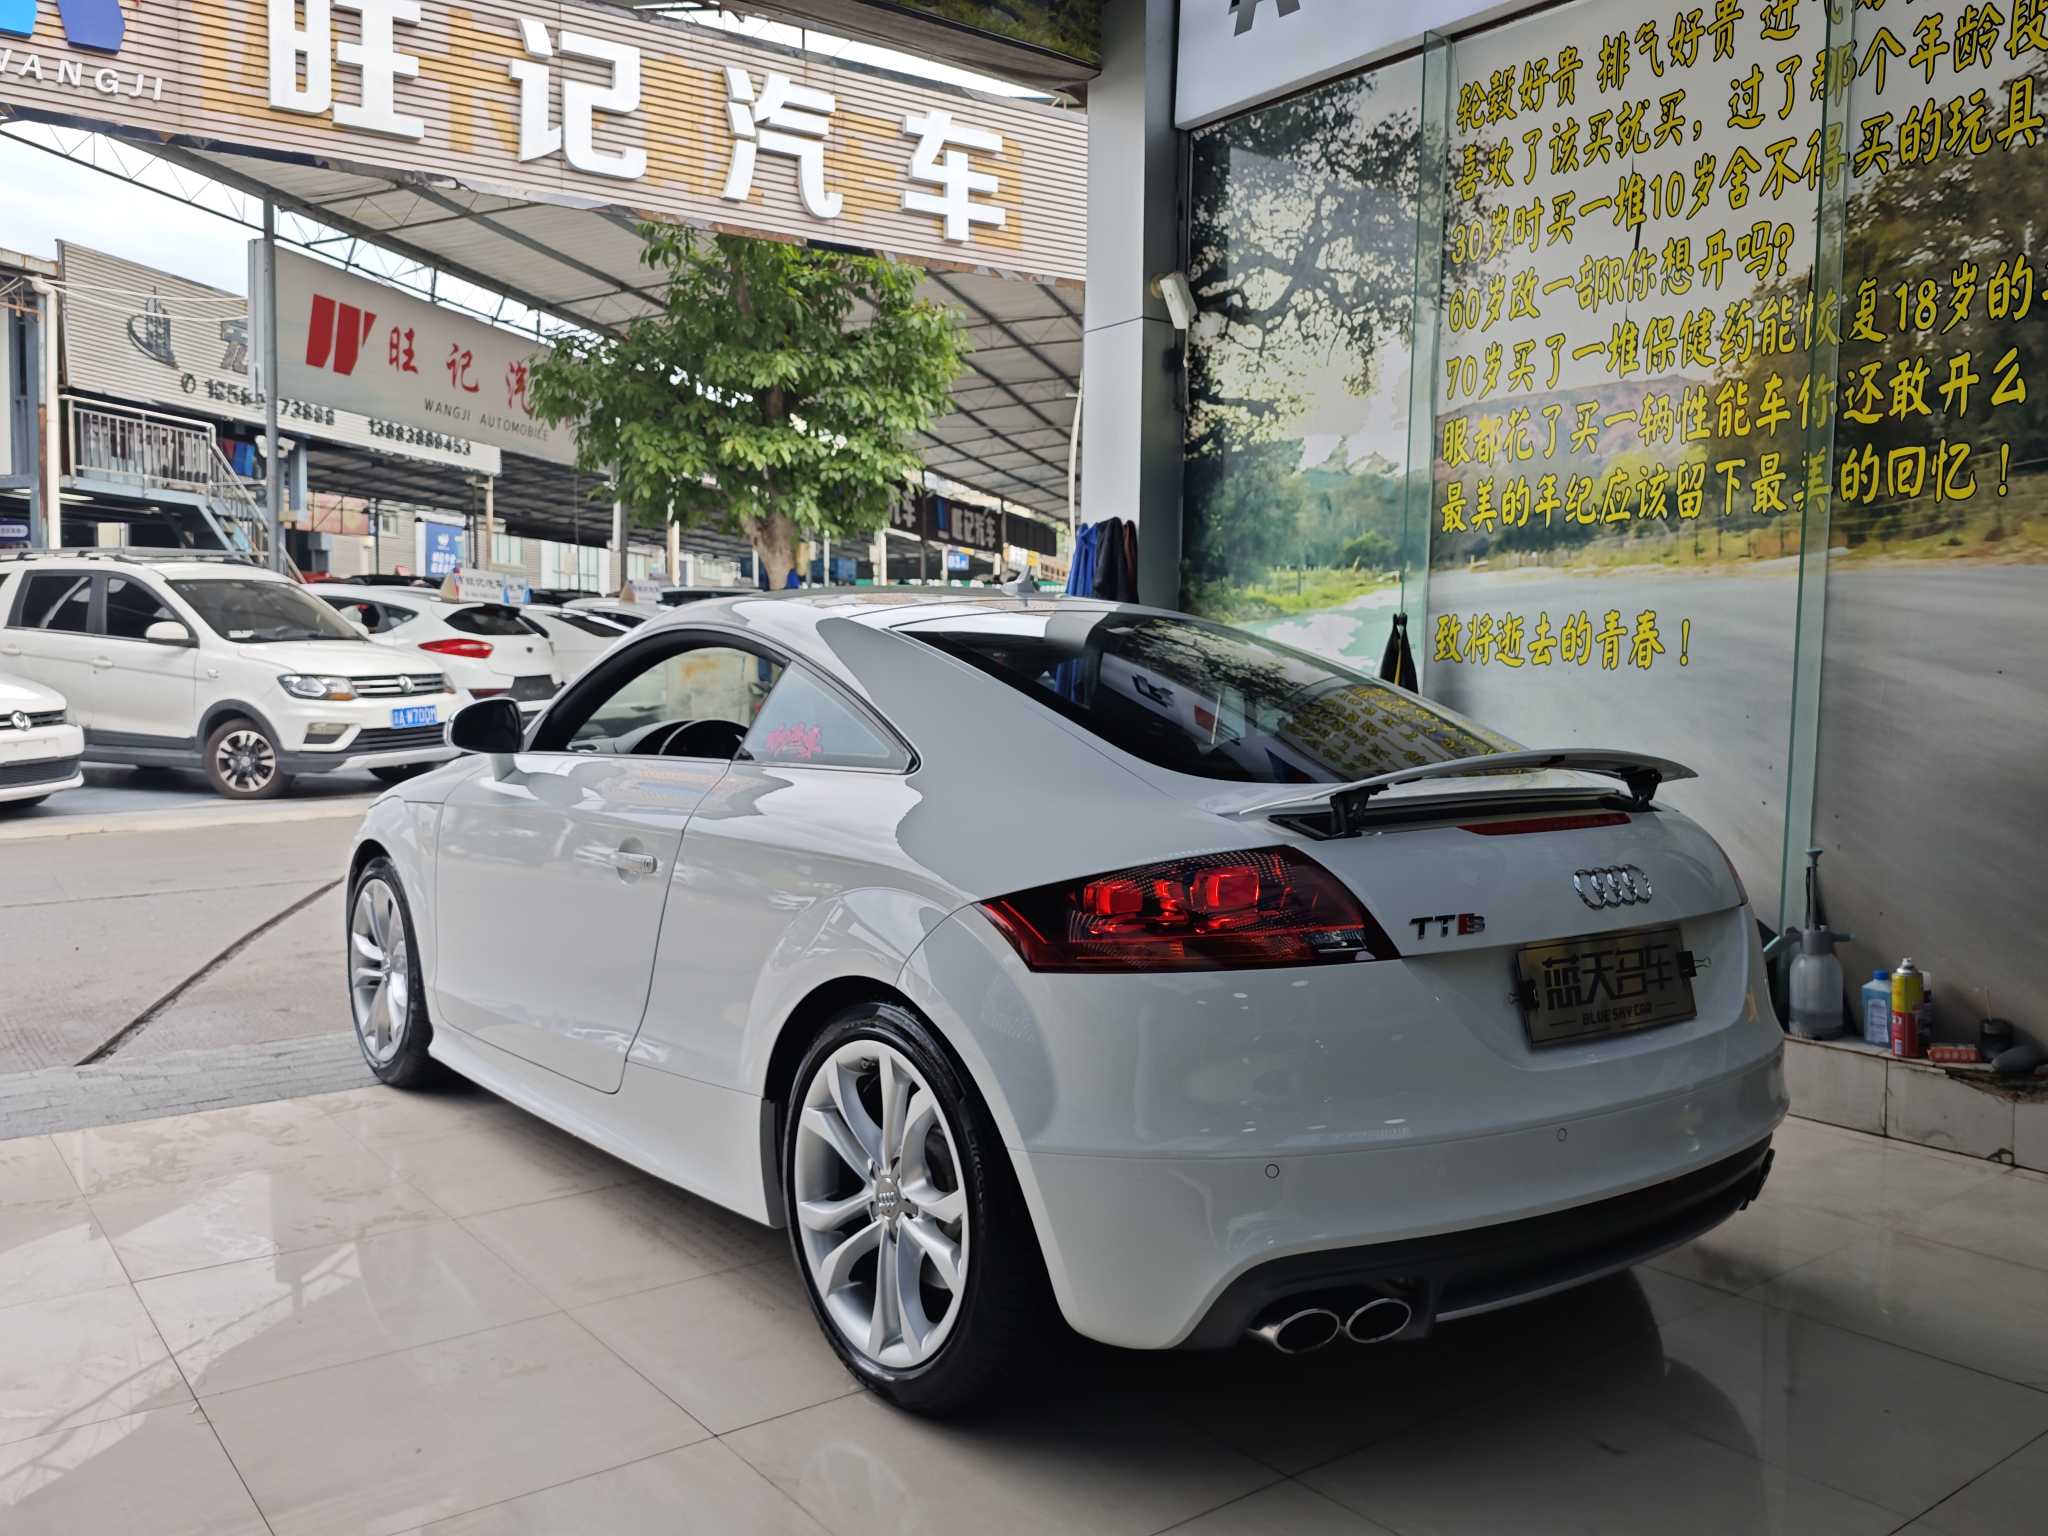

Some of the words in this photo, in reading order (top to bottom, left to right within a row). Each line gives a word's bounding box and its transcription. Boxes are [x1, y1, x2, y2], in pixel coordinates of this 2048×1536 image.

[1456, 45, 1583, 133] 轮毂好贵
[1597, 0, 1744, 92] 排气好贵
[266, 0, 1007, 243] 旺记汽车
[1446, 253, 2048, 401] 70岁买了一堆保健药能恢复18岁的
[424, 398, 471, 423] WANGJI
[480, 413, 549, 442] AUTOMOBILE
[1409, 912, 1486, 940] TTS
[1583, 1008, 1611, 1025] BLUE
[1612, 1005, 1632, 1020] SKY
